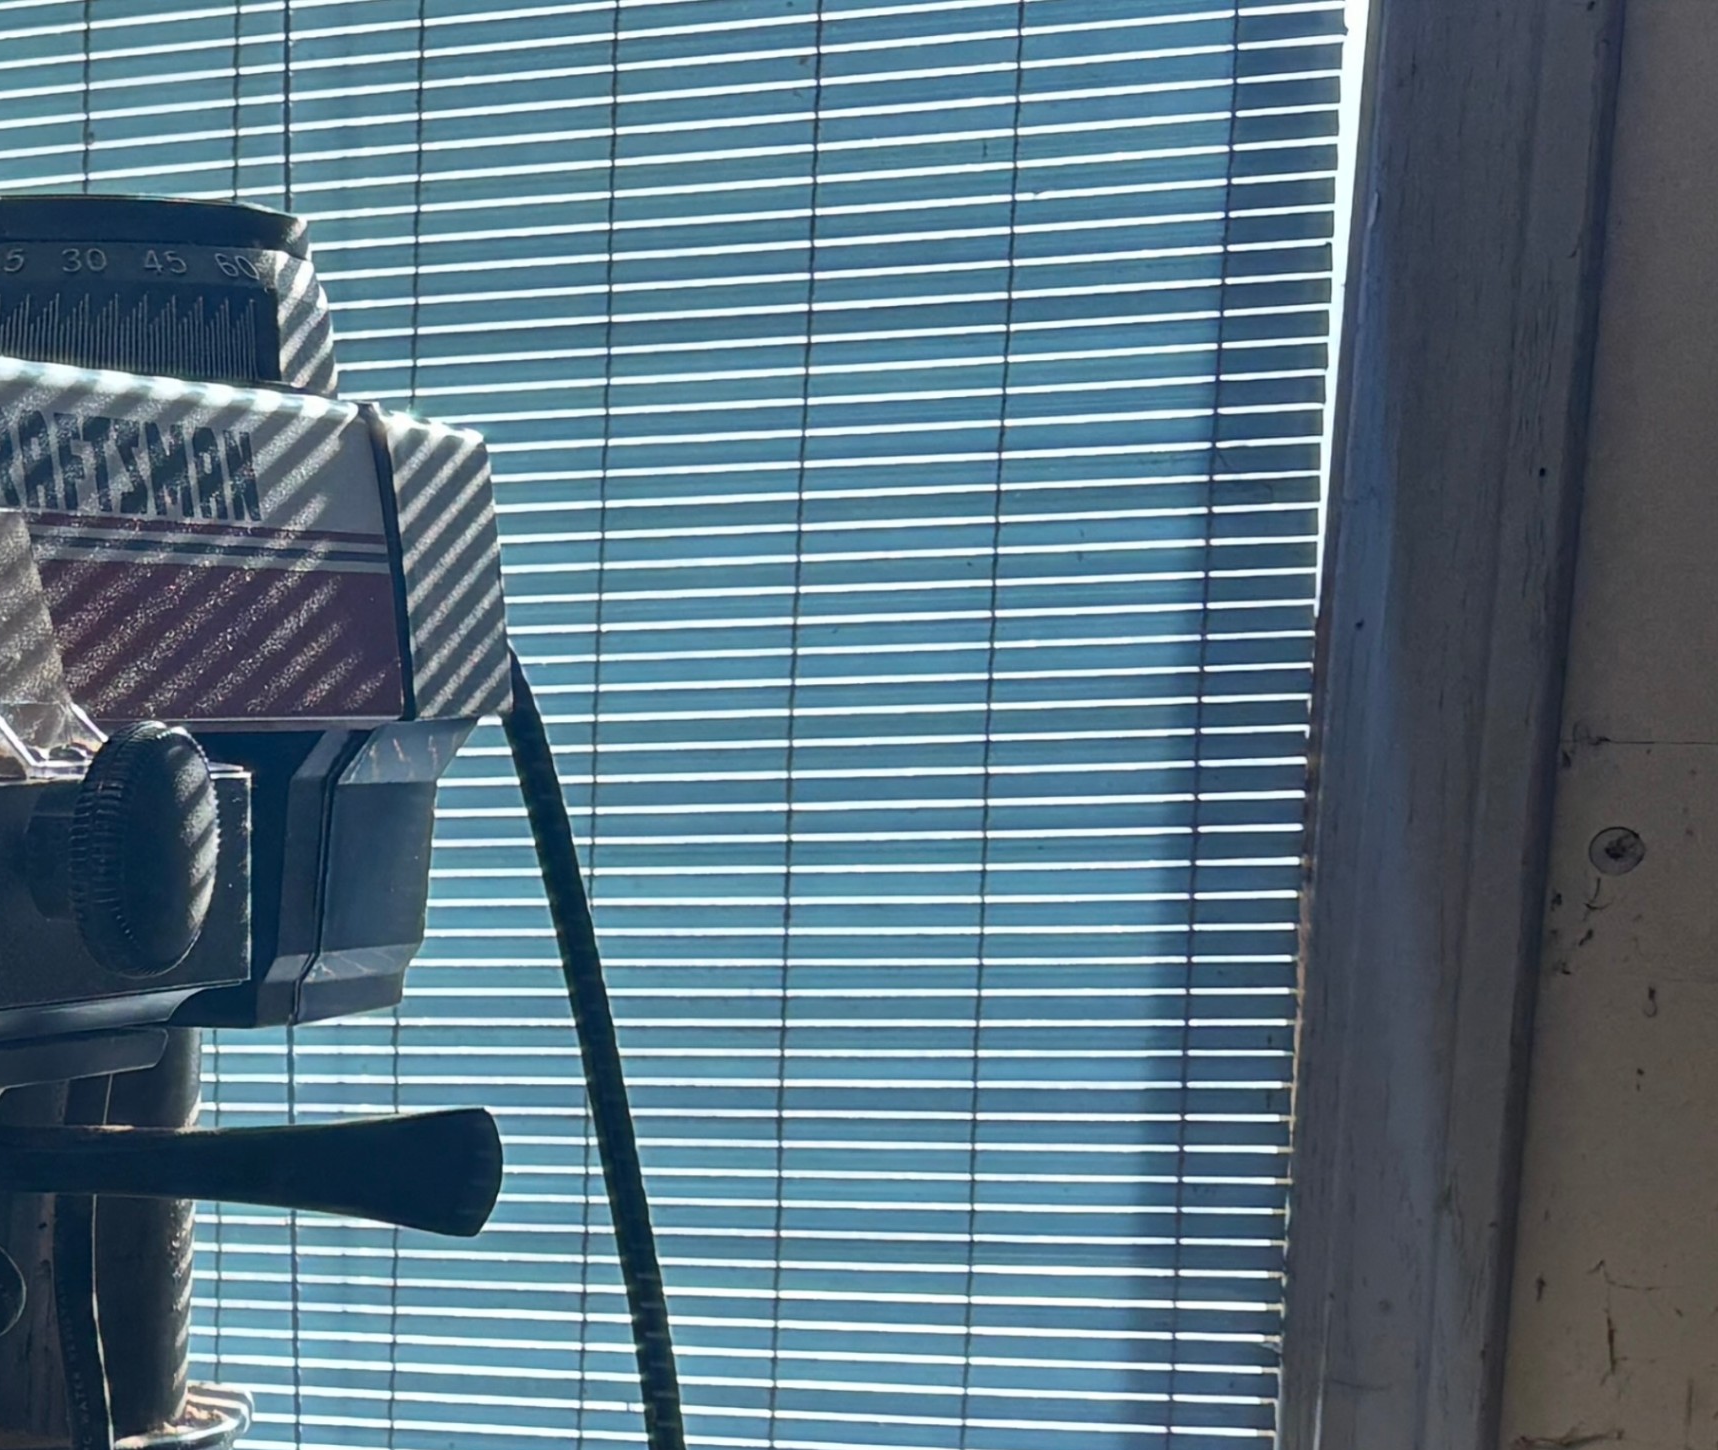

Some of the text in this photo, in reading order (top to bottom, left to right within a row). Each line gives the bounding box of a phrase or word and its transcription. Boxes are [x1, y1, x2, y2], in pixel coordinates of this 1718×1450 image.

[62, 247, 108, 273] 30
[143, 249, 187, 275] 45
[213, 252, 261, 281] 60
